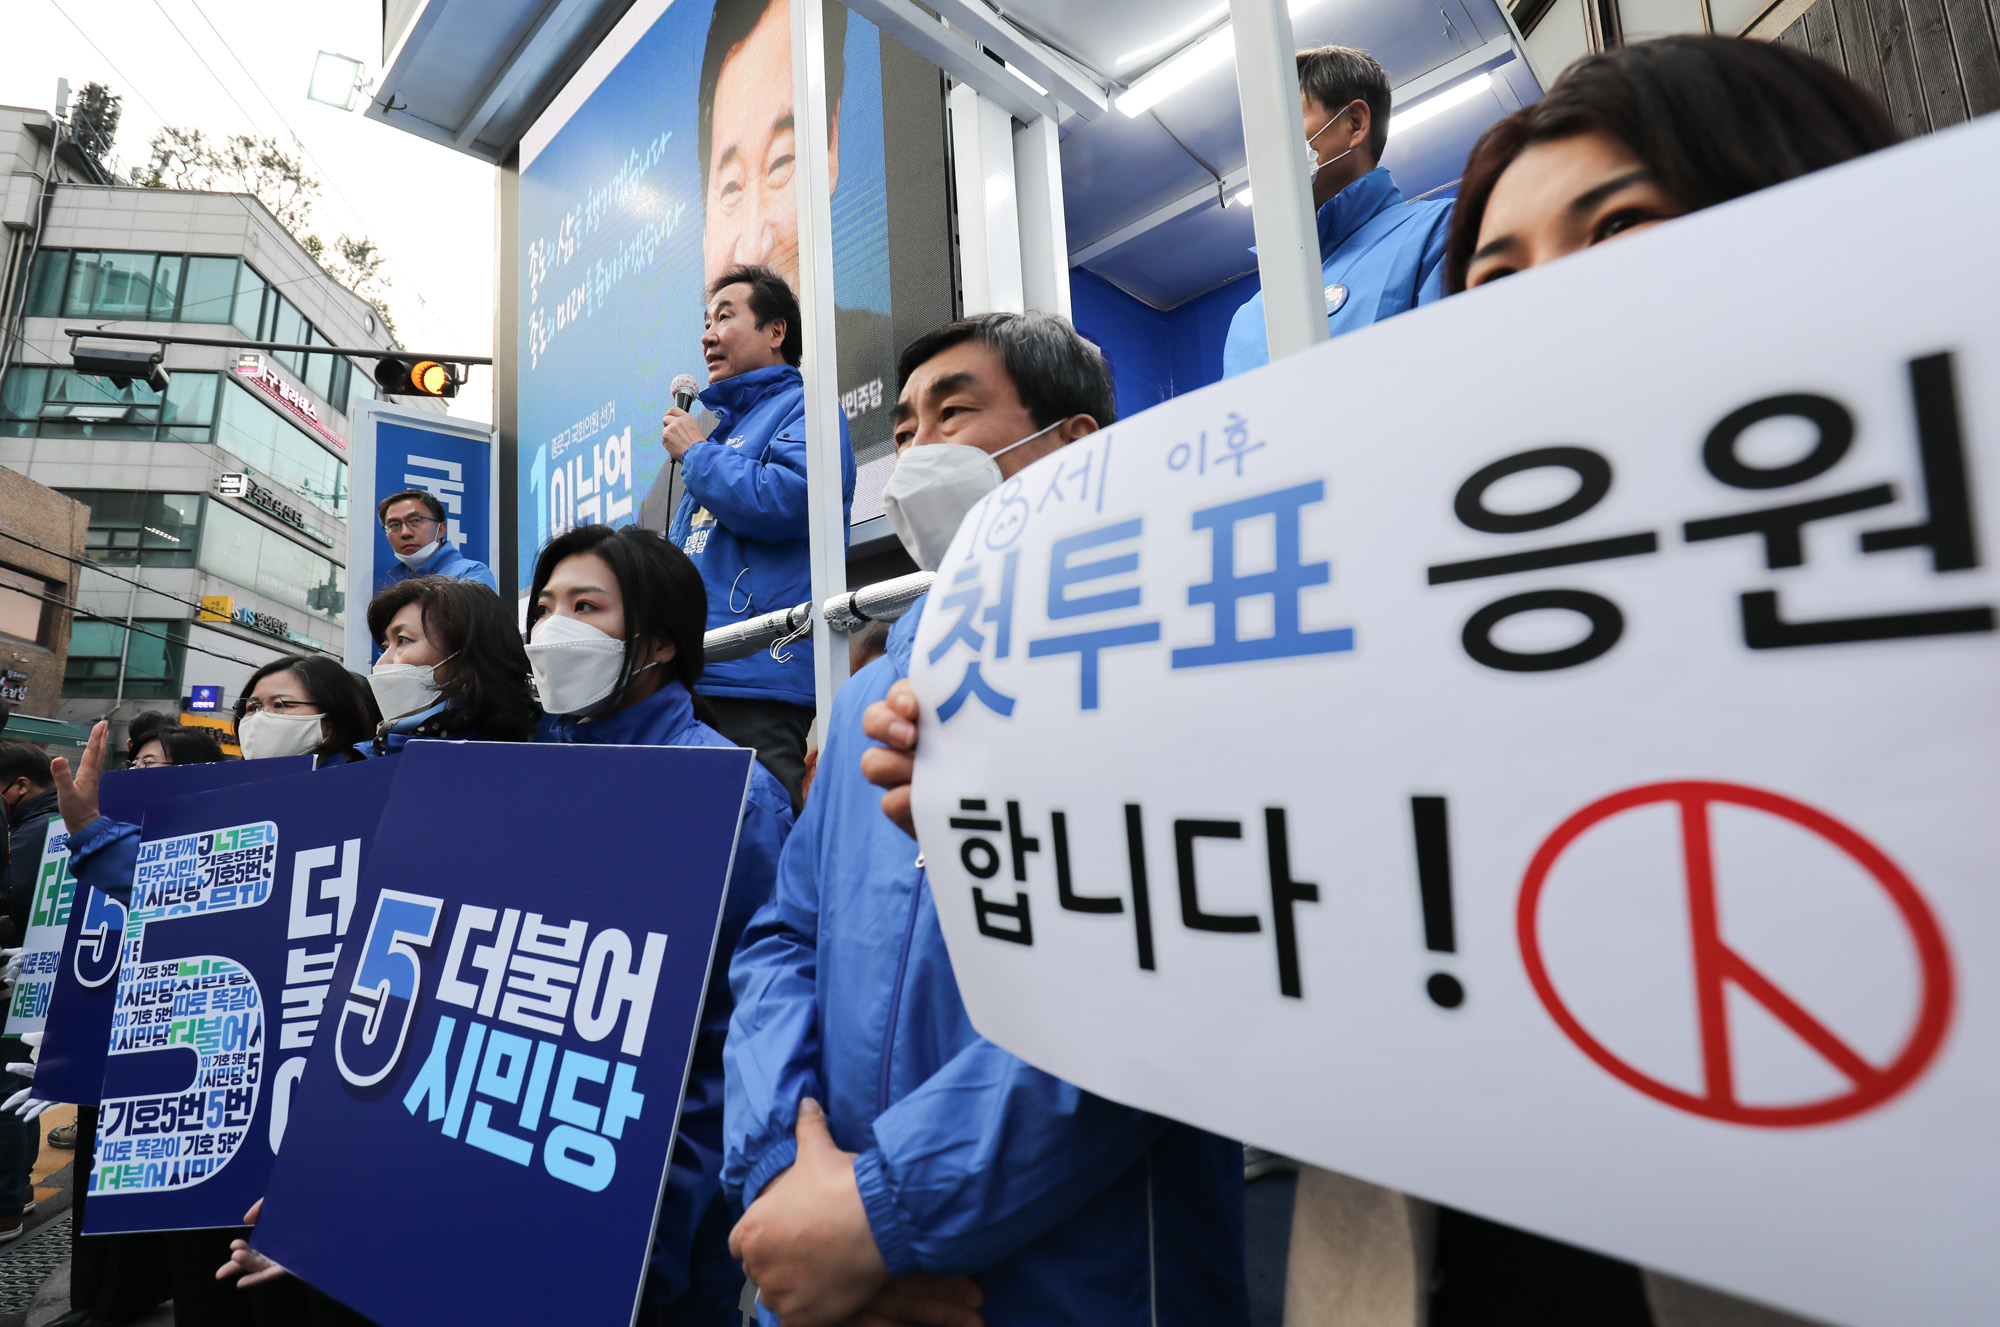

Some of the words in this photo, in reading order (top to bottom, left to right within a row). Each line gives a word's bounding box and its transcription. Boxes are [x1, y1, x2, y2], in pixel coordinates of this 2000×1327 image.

[528, 237, 555, 305] 종로의
[528, 307, 555, 371] 종로의
[550, 428, 571, 460] 종로구
[571, 409, 599, 445] 국회의원
[600, 399, 616, 429] 선거
[841, 377, 884, 421] 민주당
[1166, 412, 1266, 477] 이후
[550, 424, 633, 540] 이낙연
[928, 477, 1355, 725] 첫투표
[1426, 349, 2000, 674] 응원
[164, 836, 199, 860] 함께
[74, 879, 128, 988] 5
[949, 799, 1320, 1001] 합니다
[1409, 795, 1466, 1009] !
[12, 981, 52, 1018] 더불어
[211, 985, 260, 1013] 똑같
[335, 888, 444, 1087] 5
[435, 904, 668, 1057] 더불어
[130, 1009, 152, 1026] 기호
[154, 1006, 173, 1024] 5번
[212, 1053, 231, 1067] 기호
[231, 1052, 246, 1065] 5번
[402, 1015, 645, 1193] 시민당
[102, 1140, 133, 1163] 따로
[135, 1136, 181, 1160] 똑같이
[183, 1133, 215, 1157] 기호
